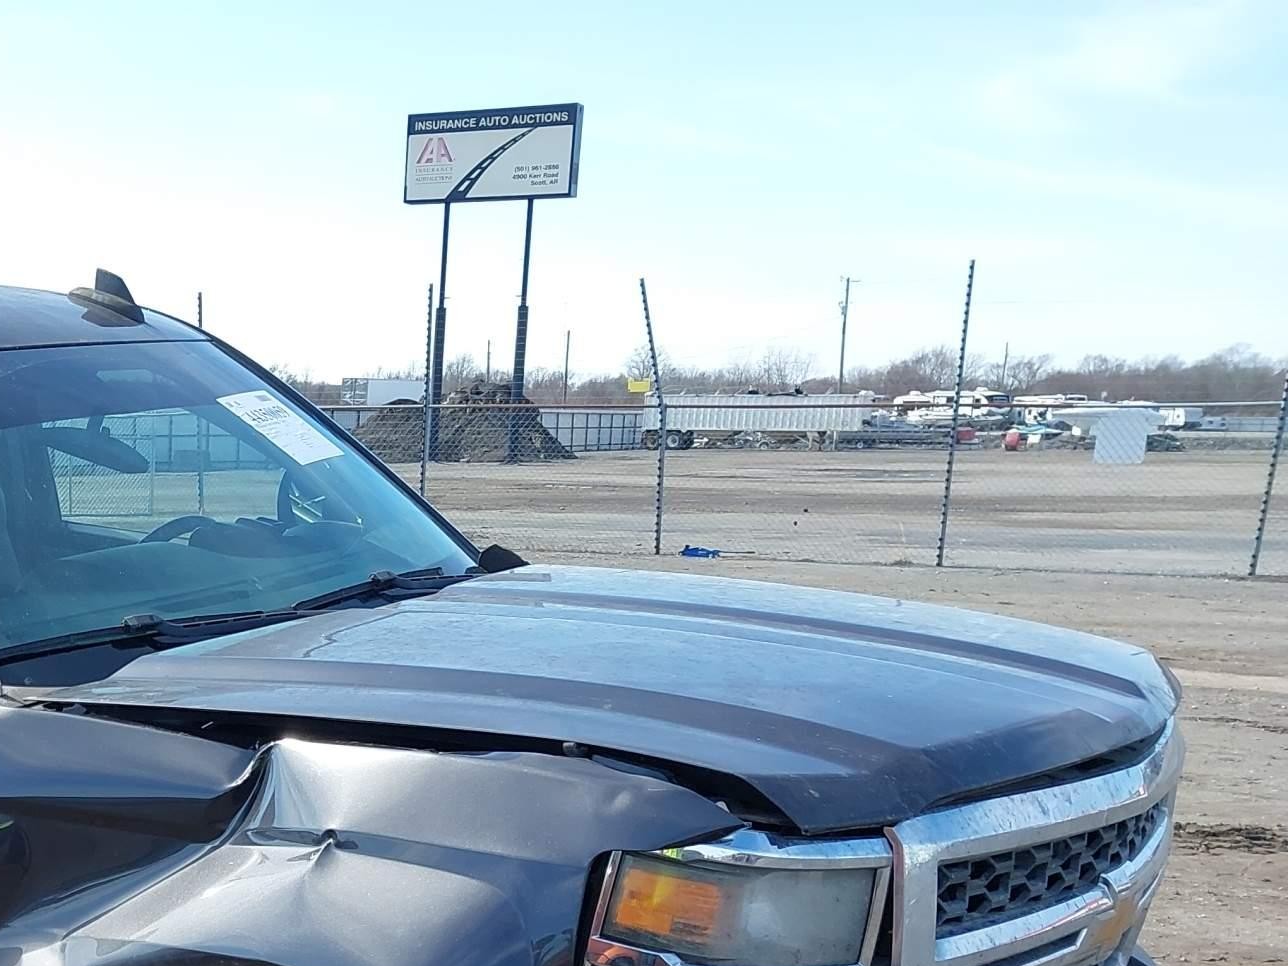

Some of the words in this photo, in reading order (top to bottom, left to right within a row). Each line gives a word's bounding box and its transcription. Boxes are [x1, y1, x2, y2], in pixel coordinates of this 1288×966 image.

[414, 117, 477, 131] INSURANCE
[478, 115, 509, 127] AUTO
[511, 111, 569, 125] AUCTIONS
